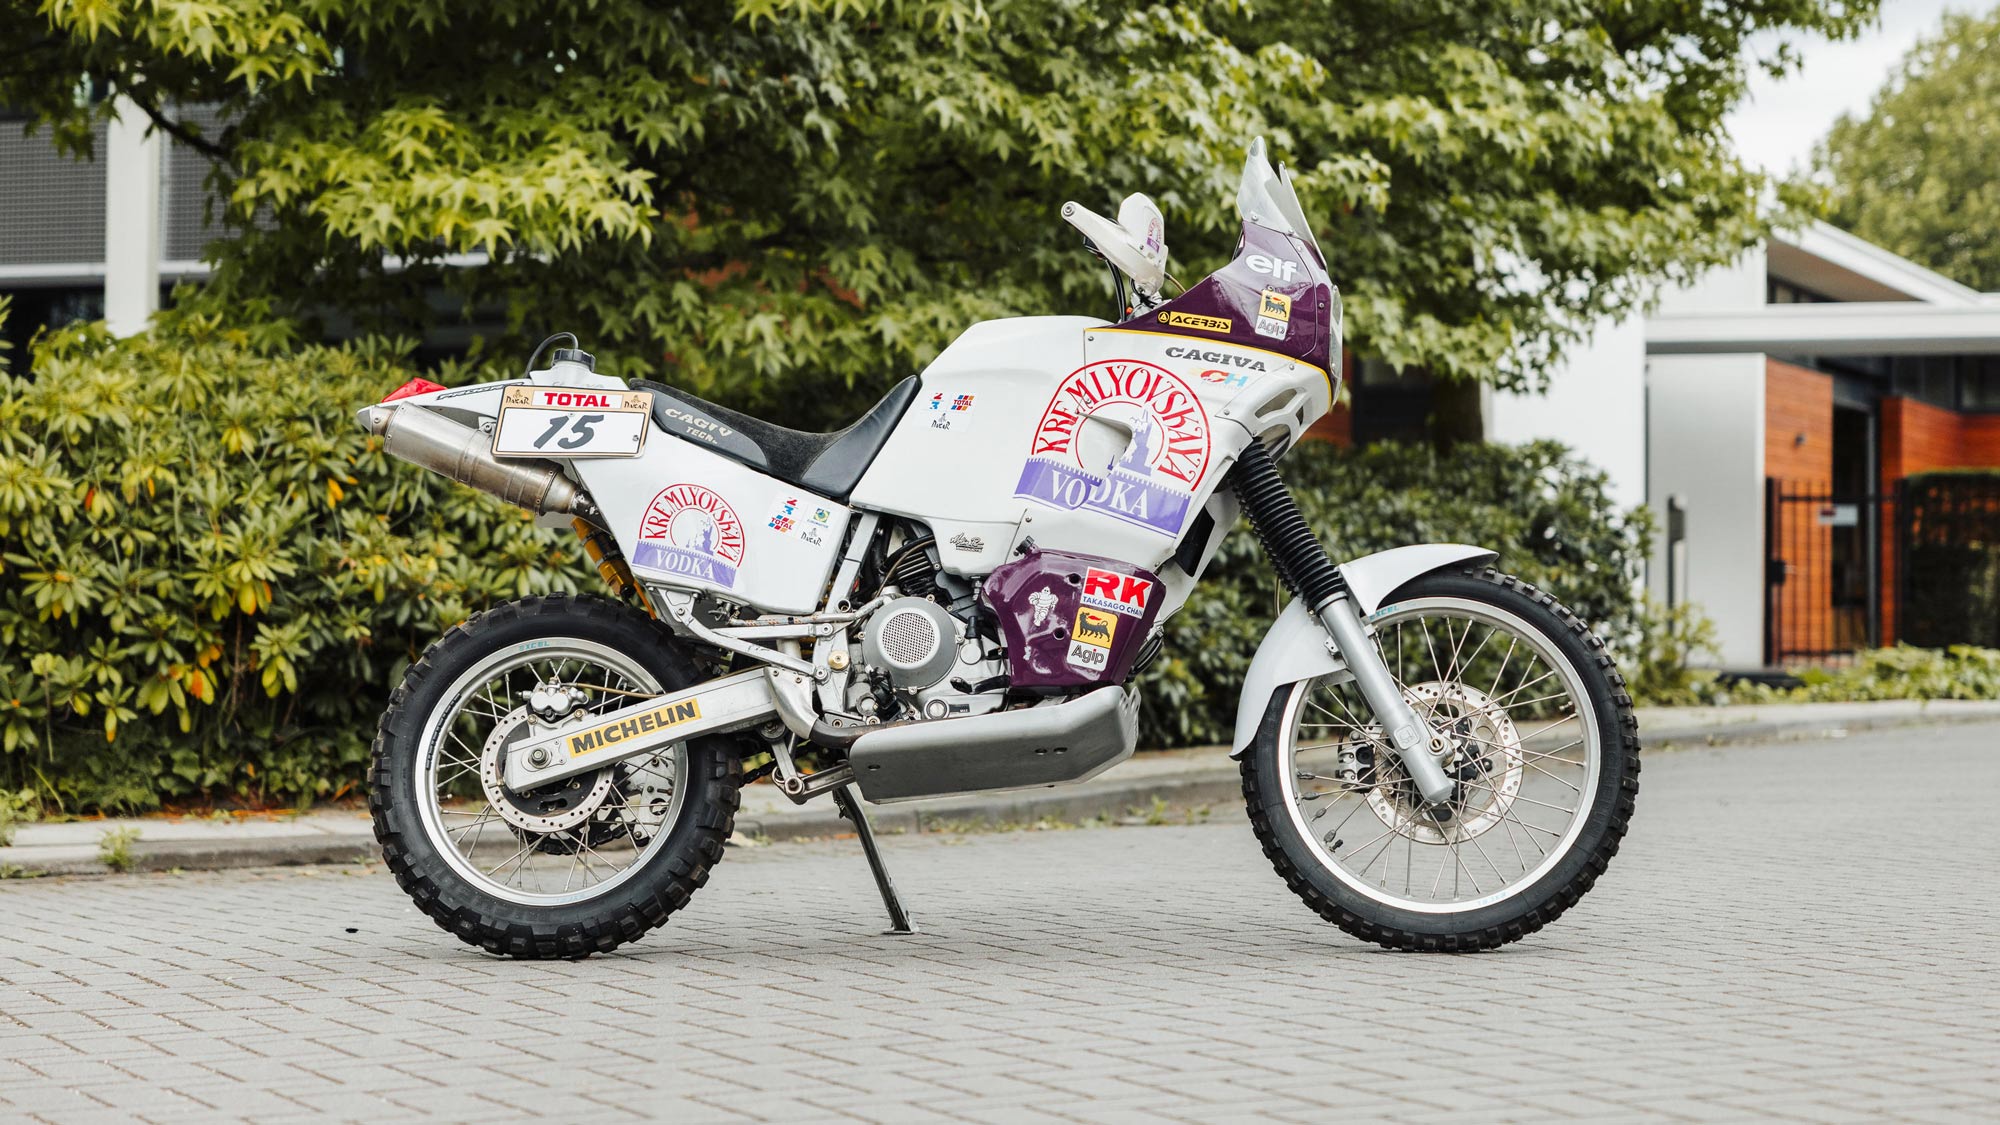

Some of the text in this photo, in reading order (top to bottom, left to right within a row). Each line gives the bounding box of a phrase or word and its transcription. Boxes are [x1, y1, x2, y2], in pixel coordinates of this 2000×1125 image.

[1245, 254, 1297, 282] elf
[1171, 315, 1230, 330] ACERBIS
[1165, 347, 1266, 373] CAGIVA
[544, 392, 610, 407] TOTAL
[533, 414, 605, 450] 15
[1051, 471, 1150, 520] VODKA
[656, 549, 715, 580] VODKA
[1084, 569, 1152, 608] RK
[1083, 595, 1126, 611] TAKASAGO
[1071, 644, 1105, 664] Agip
[572, 702, 696, 754] MICHELIN
